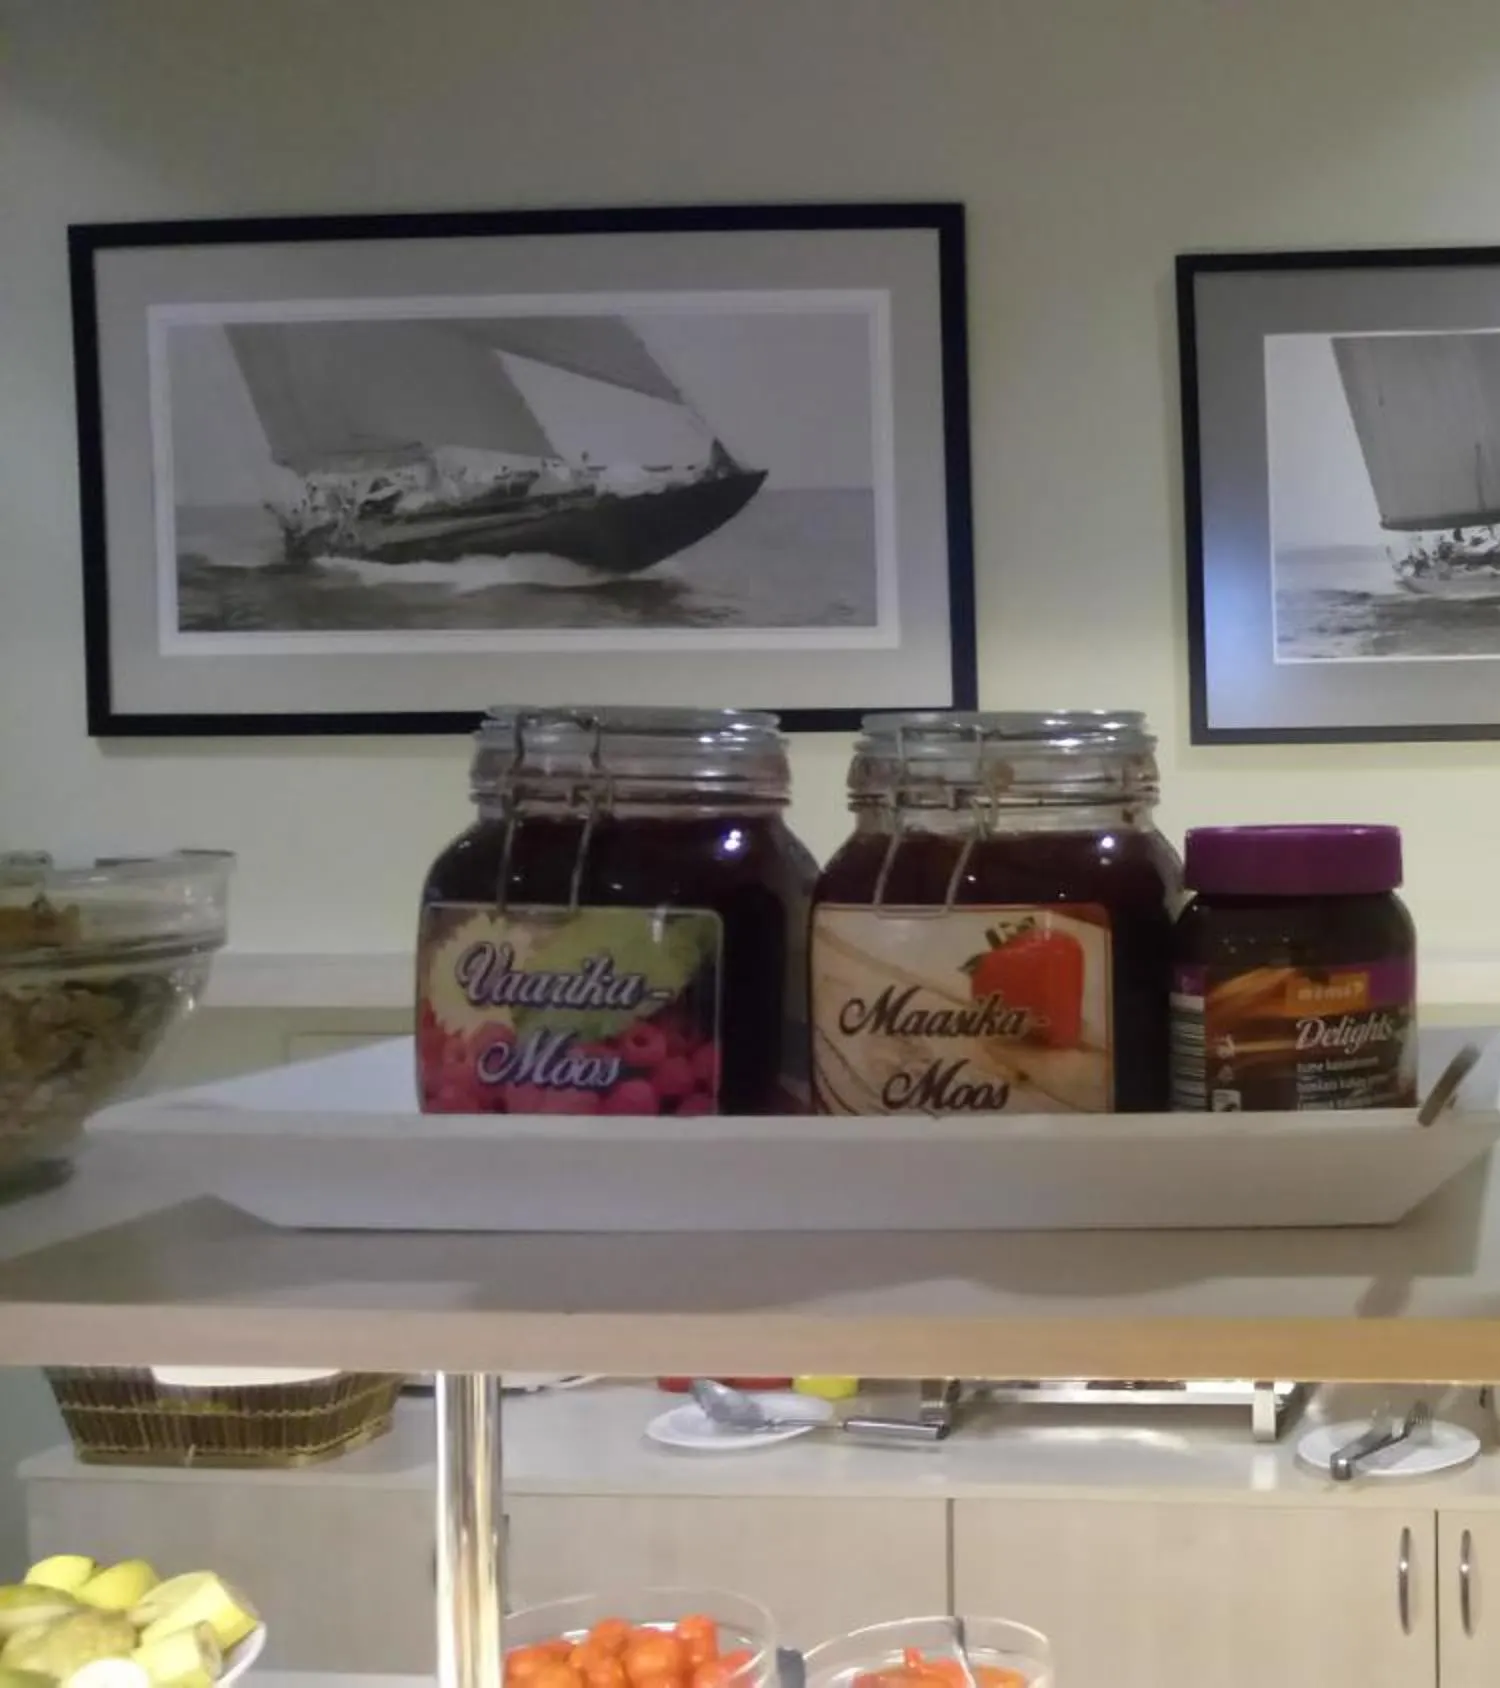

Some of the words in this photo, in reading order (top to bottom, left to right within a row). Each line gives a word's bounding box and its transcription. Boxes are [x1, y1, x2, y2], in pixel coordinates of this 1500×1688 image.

[477, 1027, 622, 1089] Moos
[1295, 1012, 1392, 1054] Delights
[881, 1058, 1010, 1110] Moos
